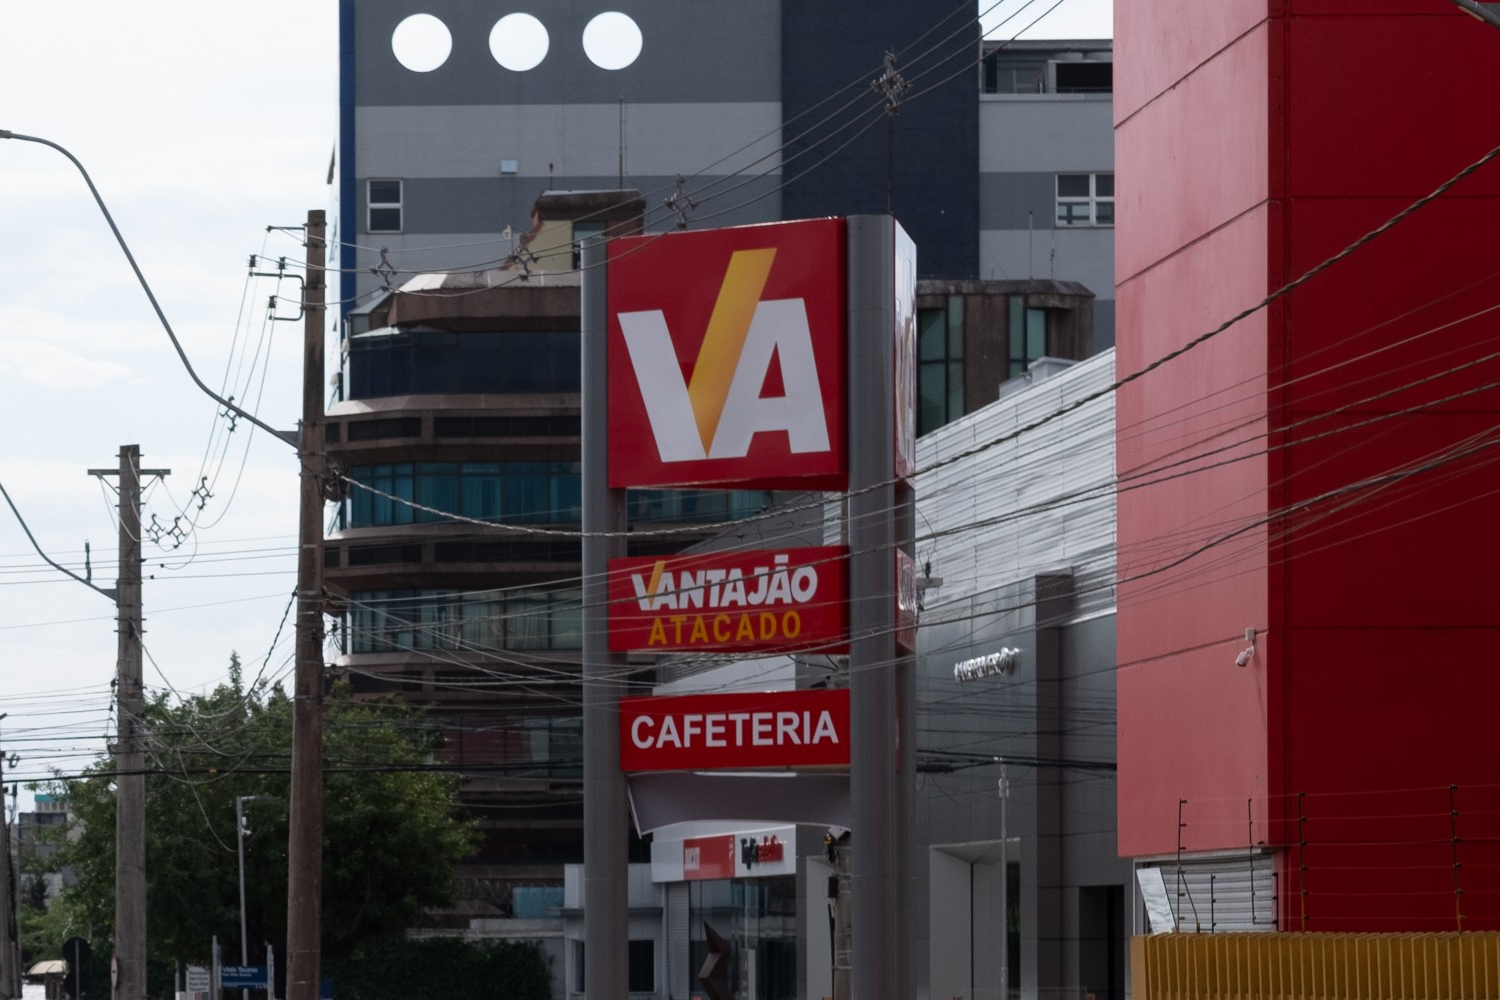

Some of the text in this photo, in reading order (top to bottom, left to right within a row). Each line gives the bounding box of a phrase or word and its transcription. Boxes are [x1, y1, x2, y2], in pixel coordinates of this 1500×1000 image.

[616, 247, 831, 463] VA
[630, 554, 818, 612] VANTAJÃO
[648, 610, 801, 646] ATACADO
[630, 709, 839, 750] CAFETERIA
